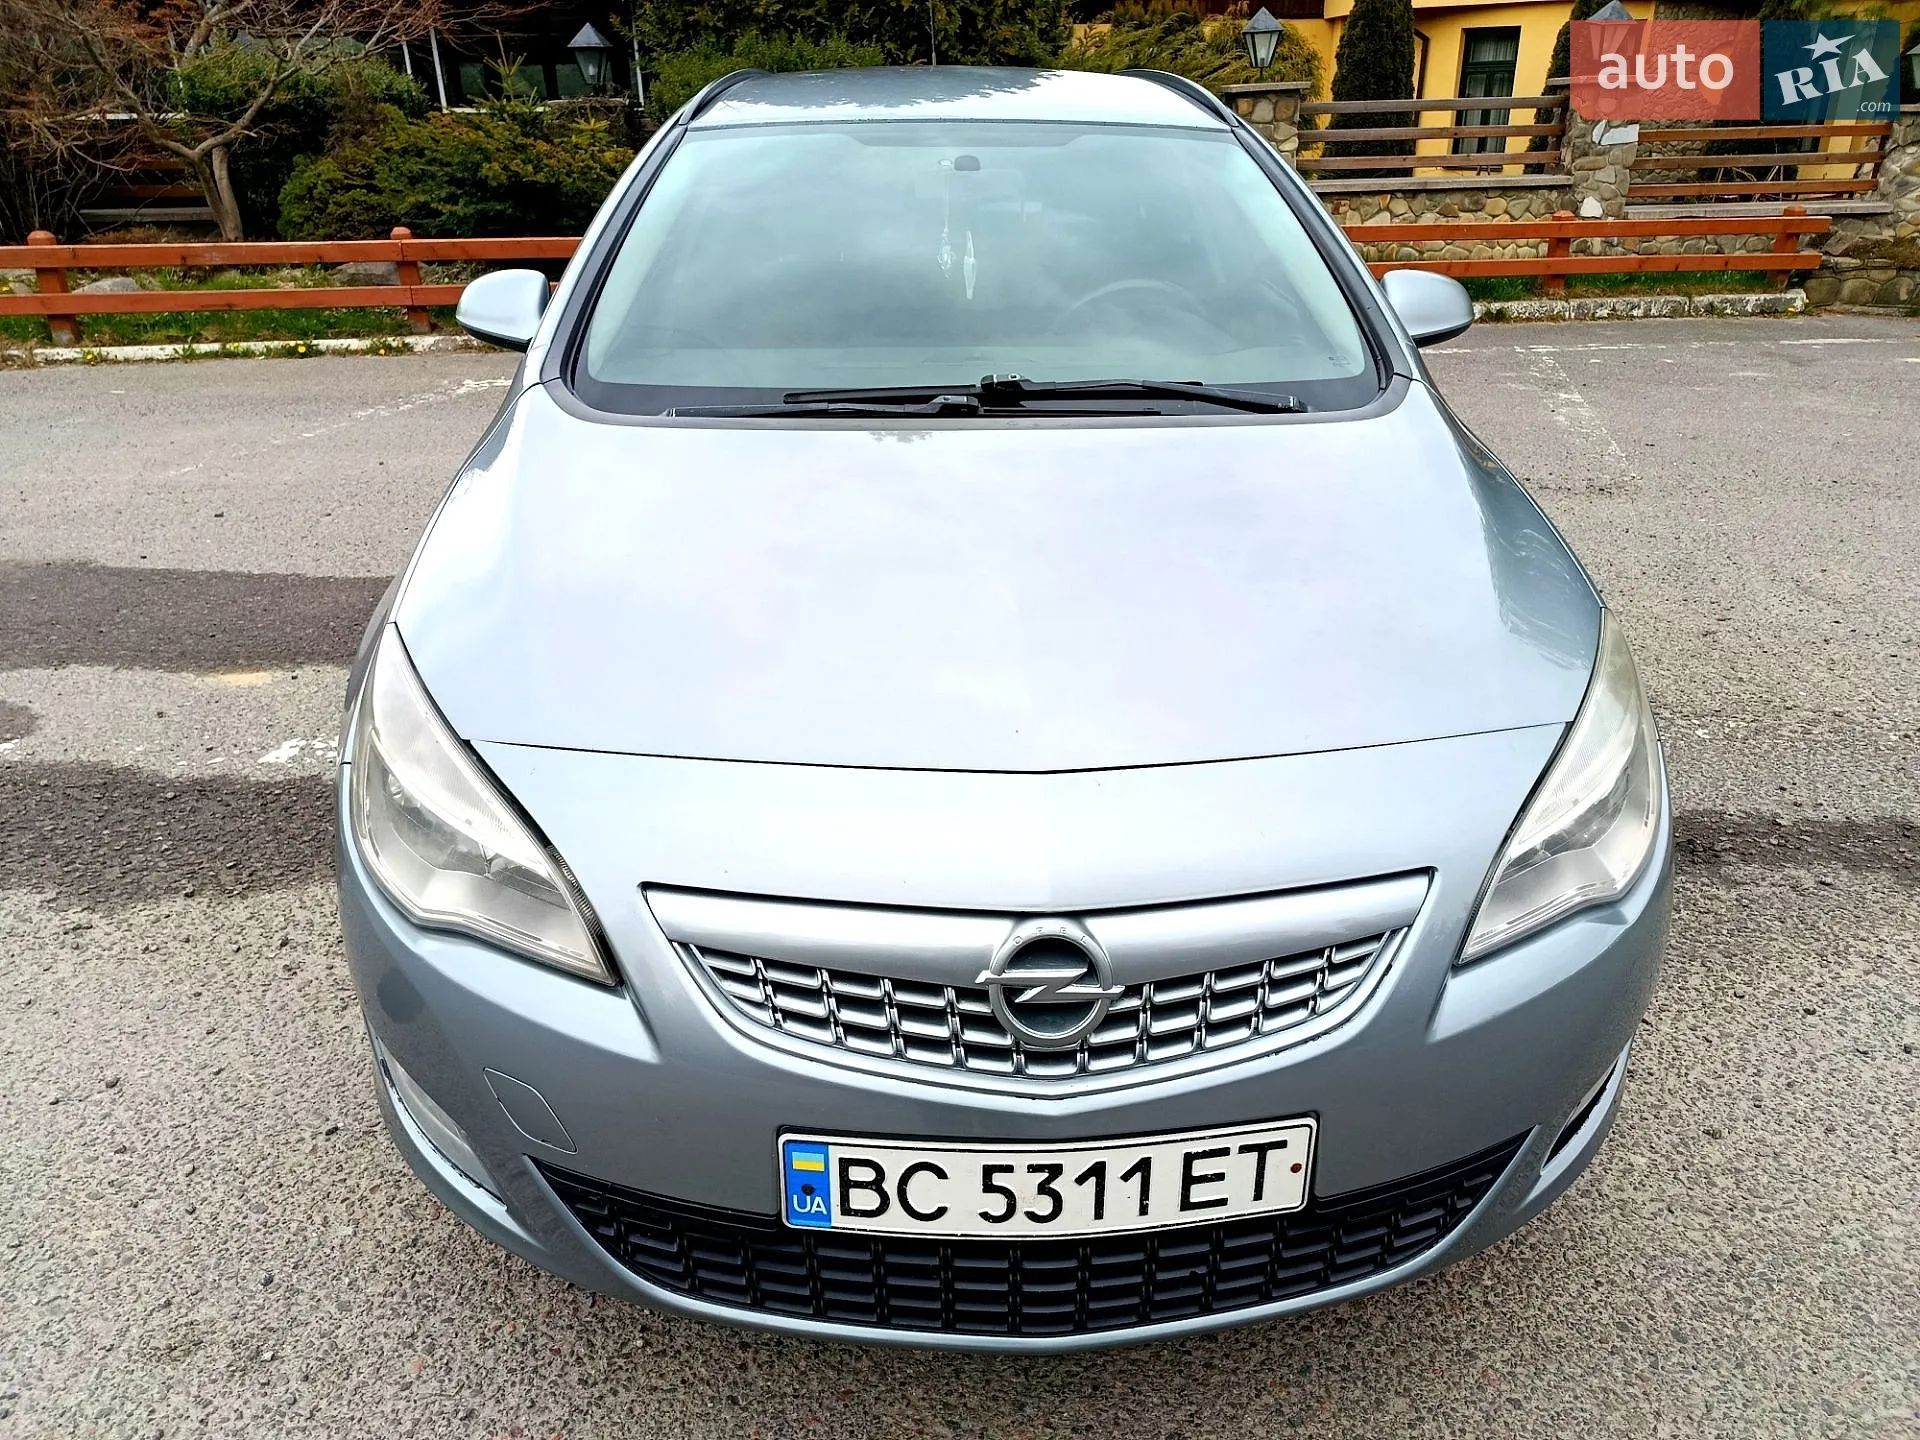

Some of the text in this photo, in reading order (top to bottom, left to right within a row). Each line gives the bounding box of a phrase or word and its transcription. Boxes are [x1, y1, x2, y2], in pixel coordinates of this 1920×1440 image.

[1013, 926, 1088, 946] OPEL
[837, 1139, 1289, 1224] BC 5311 ET
[793, 1193, 828, 1215] UA
